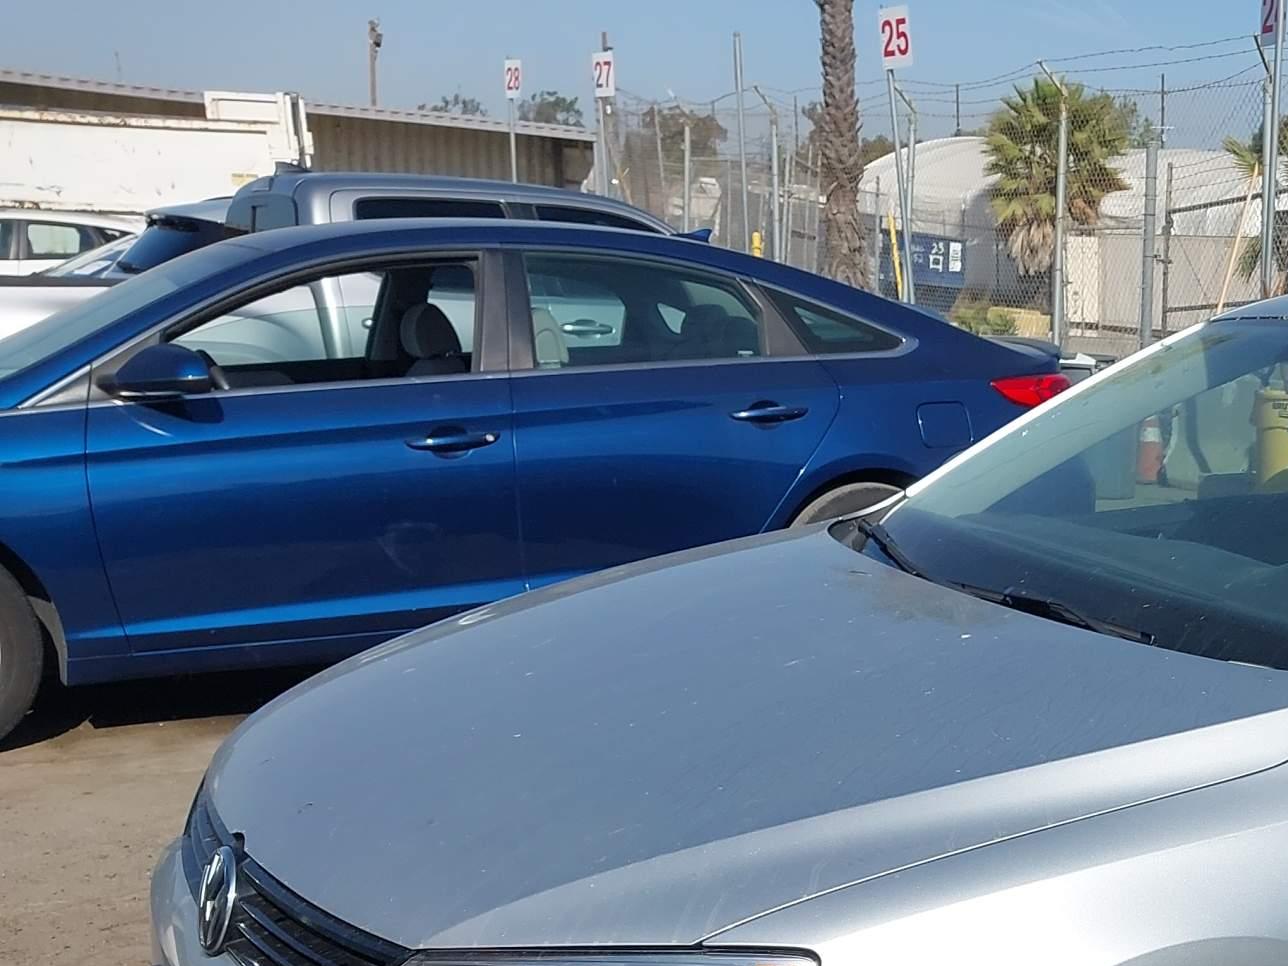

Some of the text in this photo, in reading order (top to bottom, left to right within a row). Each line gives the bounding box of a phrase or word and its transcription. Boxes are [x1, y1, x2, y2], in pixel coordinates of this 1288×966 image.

[881, 17, 909, 57] 25
[506, 67, 520, 90] 28
[594, 60, 612, 88] 27
